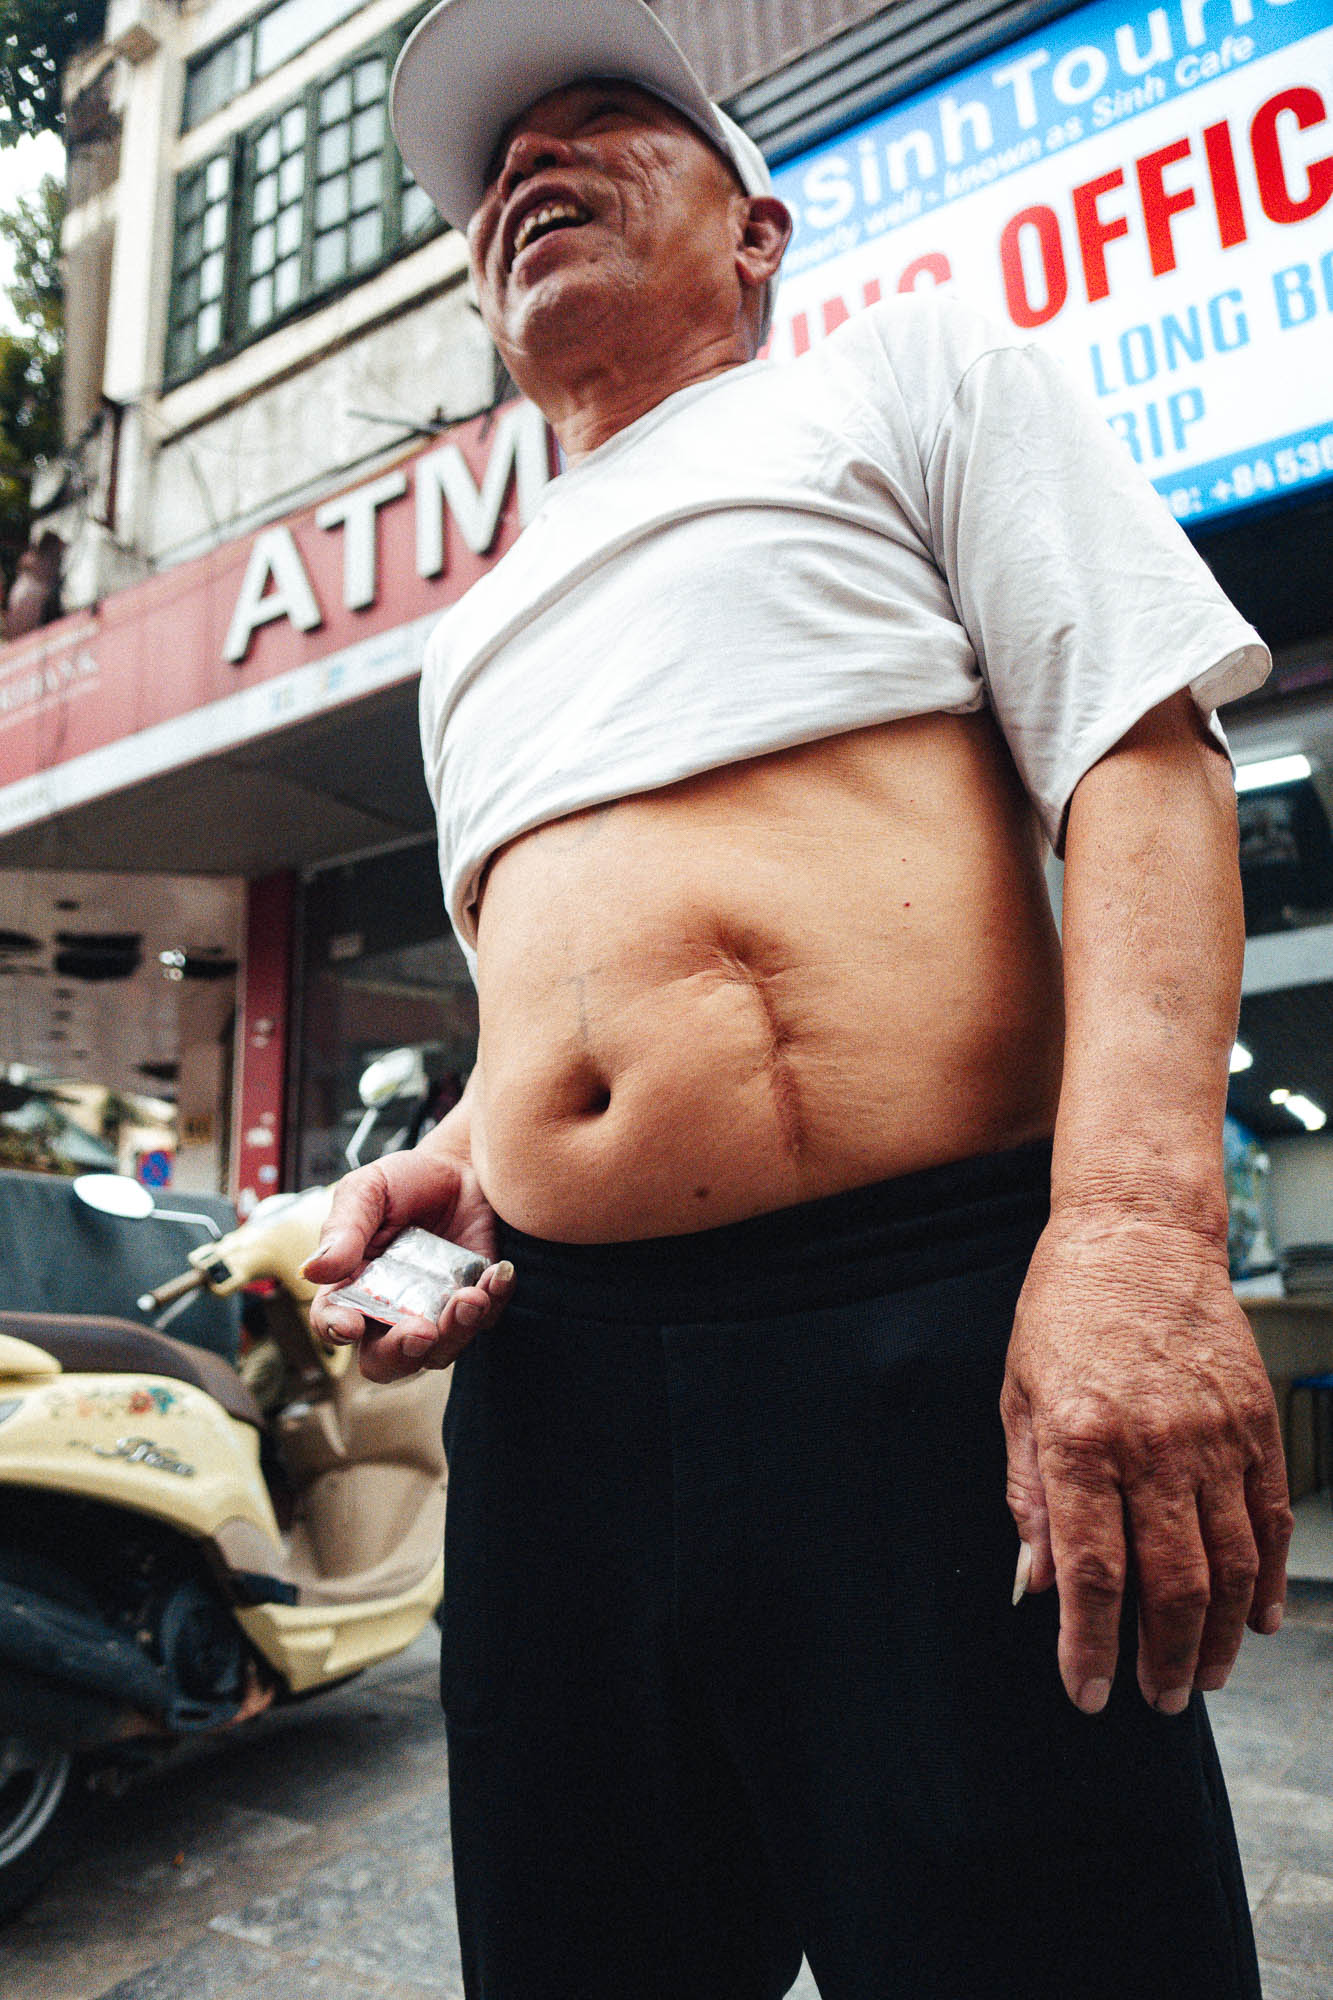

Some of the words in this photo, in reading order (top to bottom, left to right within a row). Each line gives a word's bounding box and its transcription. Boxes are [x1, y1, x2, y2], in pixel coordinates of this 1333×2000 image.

[1092, 74, 1166, 128] Sinh
[1174, 34, 1255, 89] Cafe
[999, 87, 1333, 329] OFFIC
[1090, 288, 1250, 397] LONG
[222, 397, 550, 664] ATM
